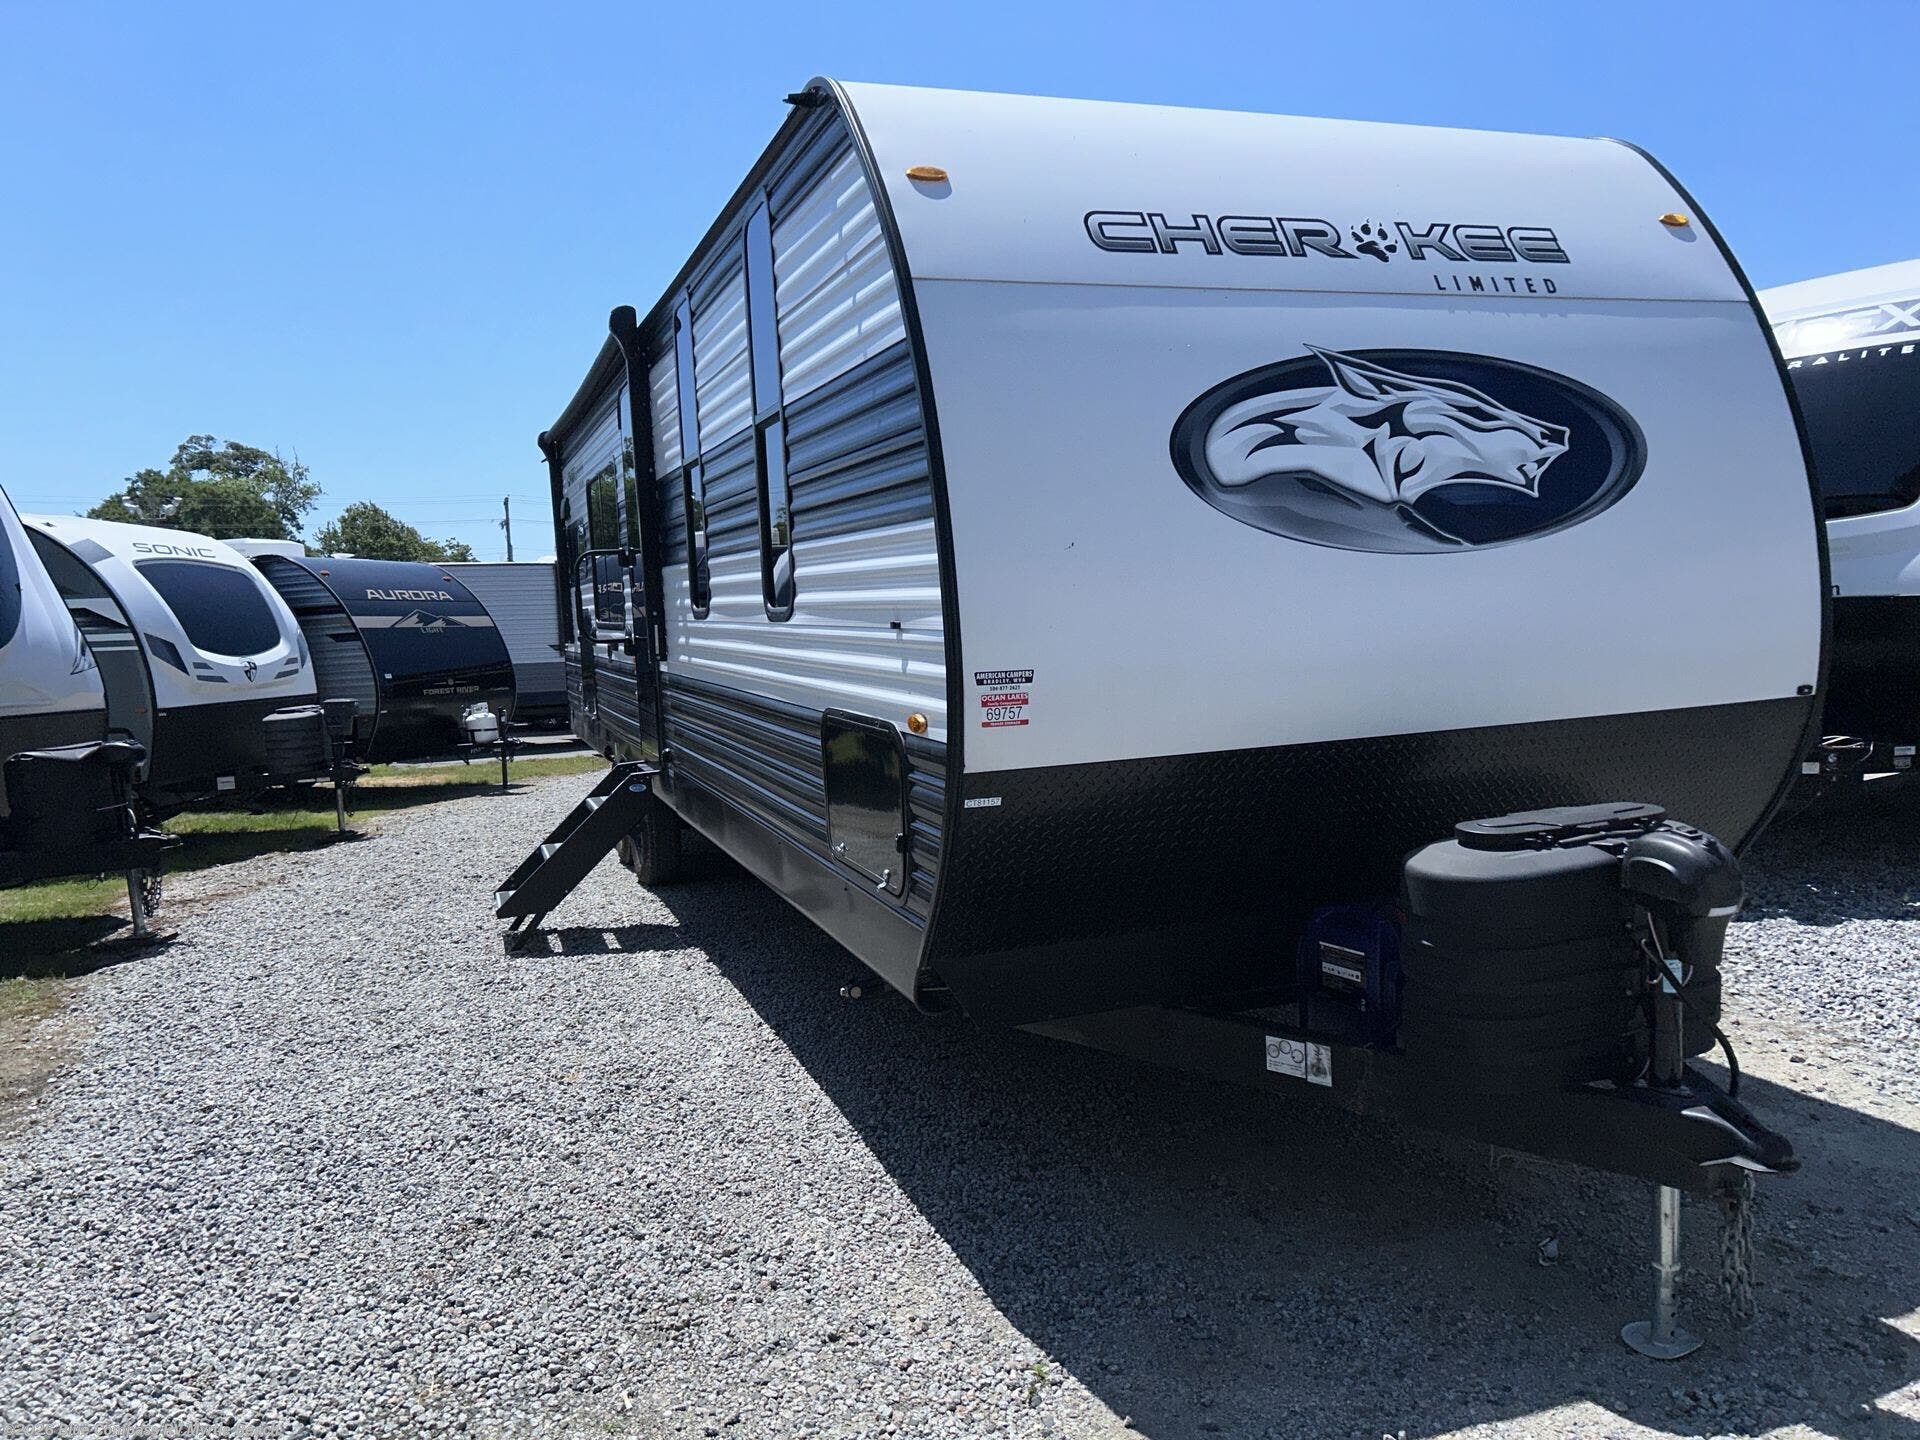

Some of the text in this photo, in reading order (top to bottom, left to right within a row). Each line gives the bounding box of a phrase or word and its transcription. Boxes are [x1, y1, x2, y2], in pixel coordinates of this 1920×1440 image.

[1083, 210, 1572, 264] CHERKEE
[1434, 274, 1557, 293] LIMITED
[1787, 344, 1916, 370] RALITE
[132, 542, 216, 559] SONIC
[366, 589, 454, 601] AURORA
[976, 670, 1033, 680] AMERICAN CAMPERS
[423, 685, 480, 695] FOREST RIVER
[981, 694, 1006, 702] OCEAN
[986, 706, 1023, 721] 69757
